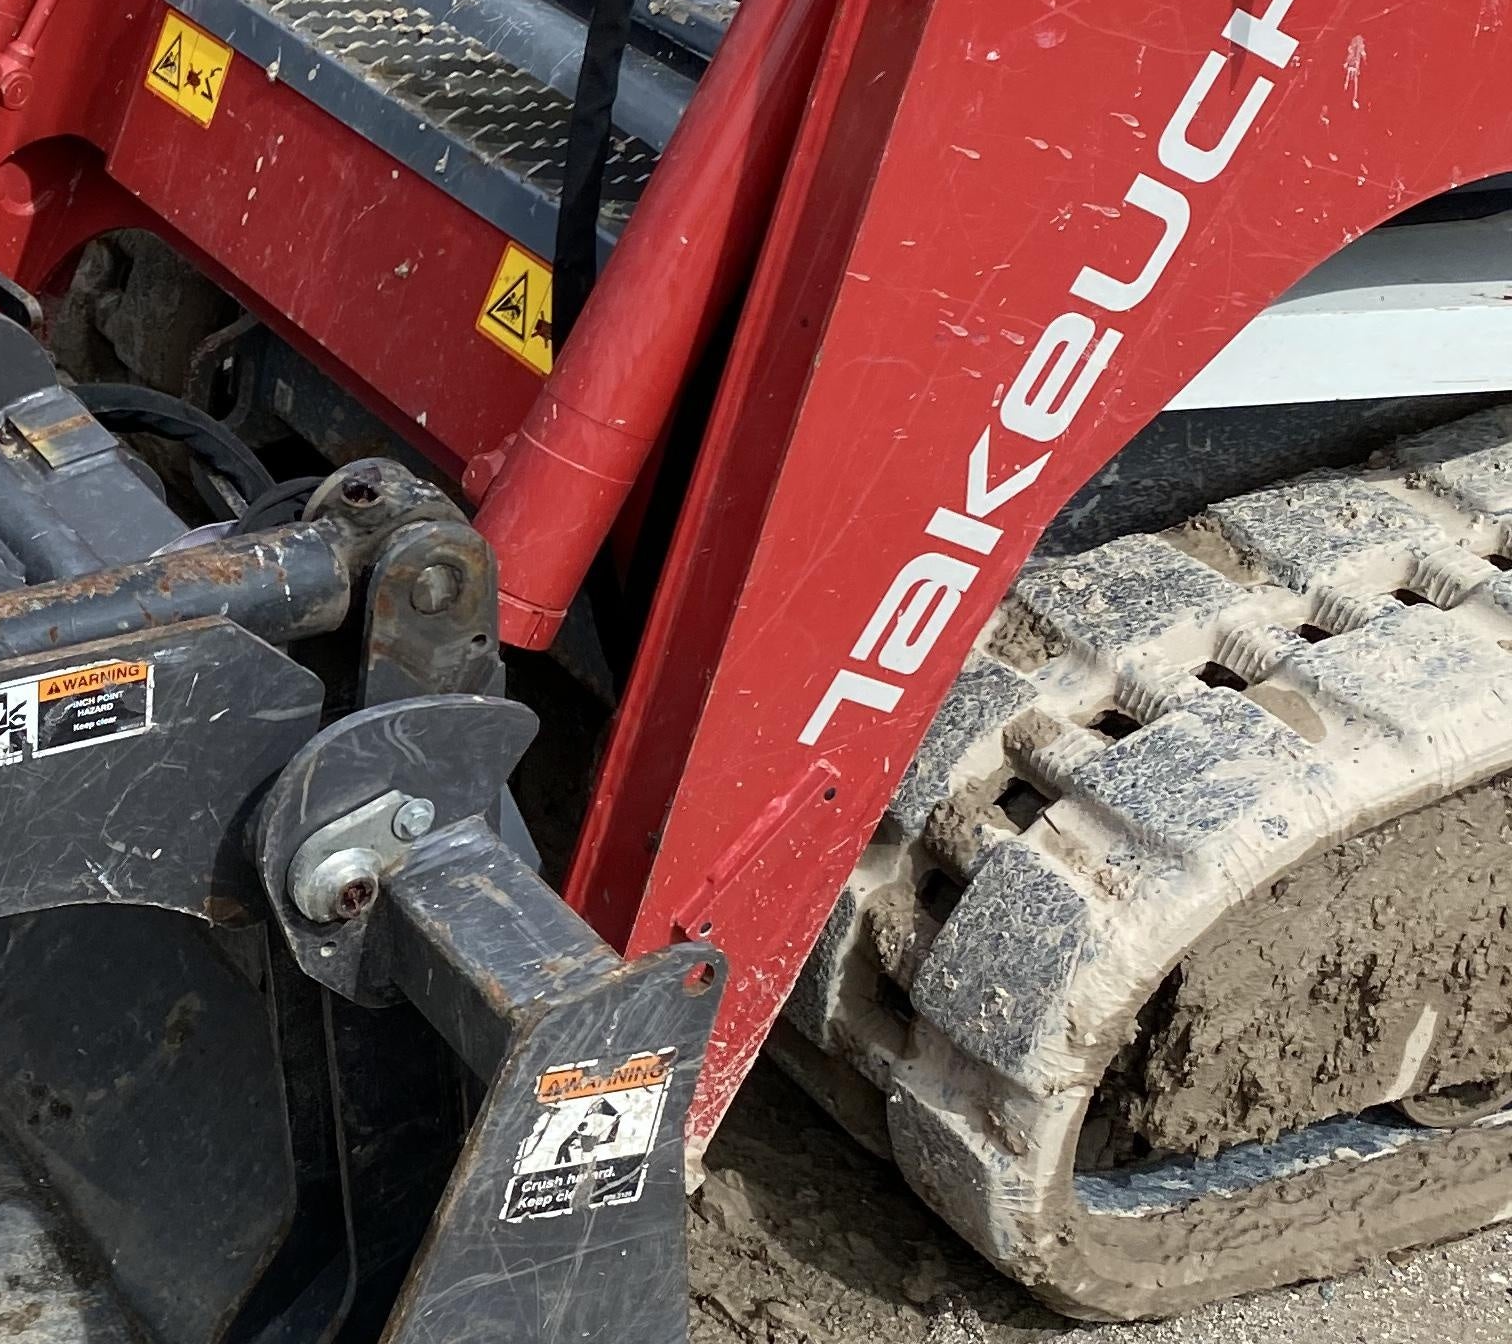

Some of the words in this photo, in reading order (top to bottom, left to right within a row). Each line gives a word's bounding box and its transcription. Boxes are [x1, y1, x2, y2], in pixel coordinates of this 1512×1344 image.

[62, 664, 141, 691] WARNING
[66, 694, 96, 711] INCH
[96, 689, 125, 704] POINT
[76, 701, 115, 718] HAZARD
[73, 719, 97, 733] Keep
[96, 714, 118, 728] clear
[521, 1174, 564, 1193] Crush
[517, 1192, 553, 1210] Keep
